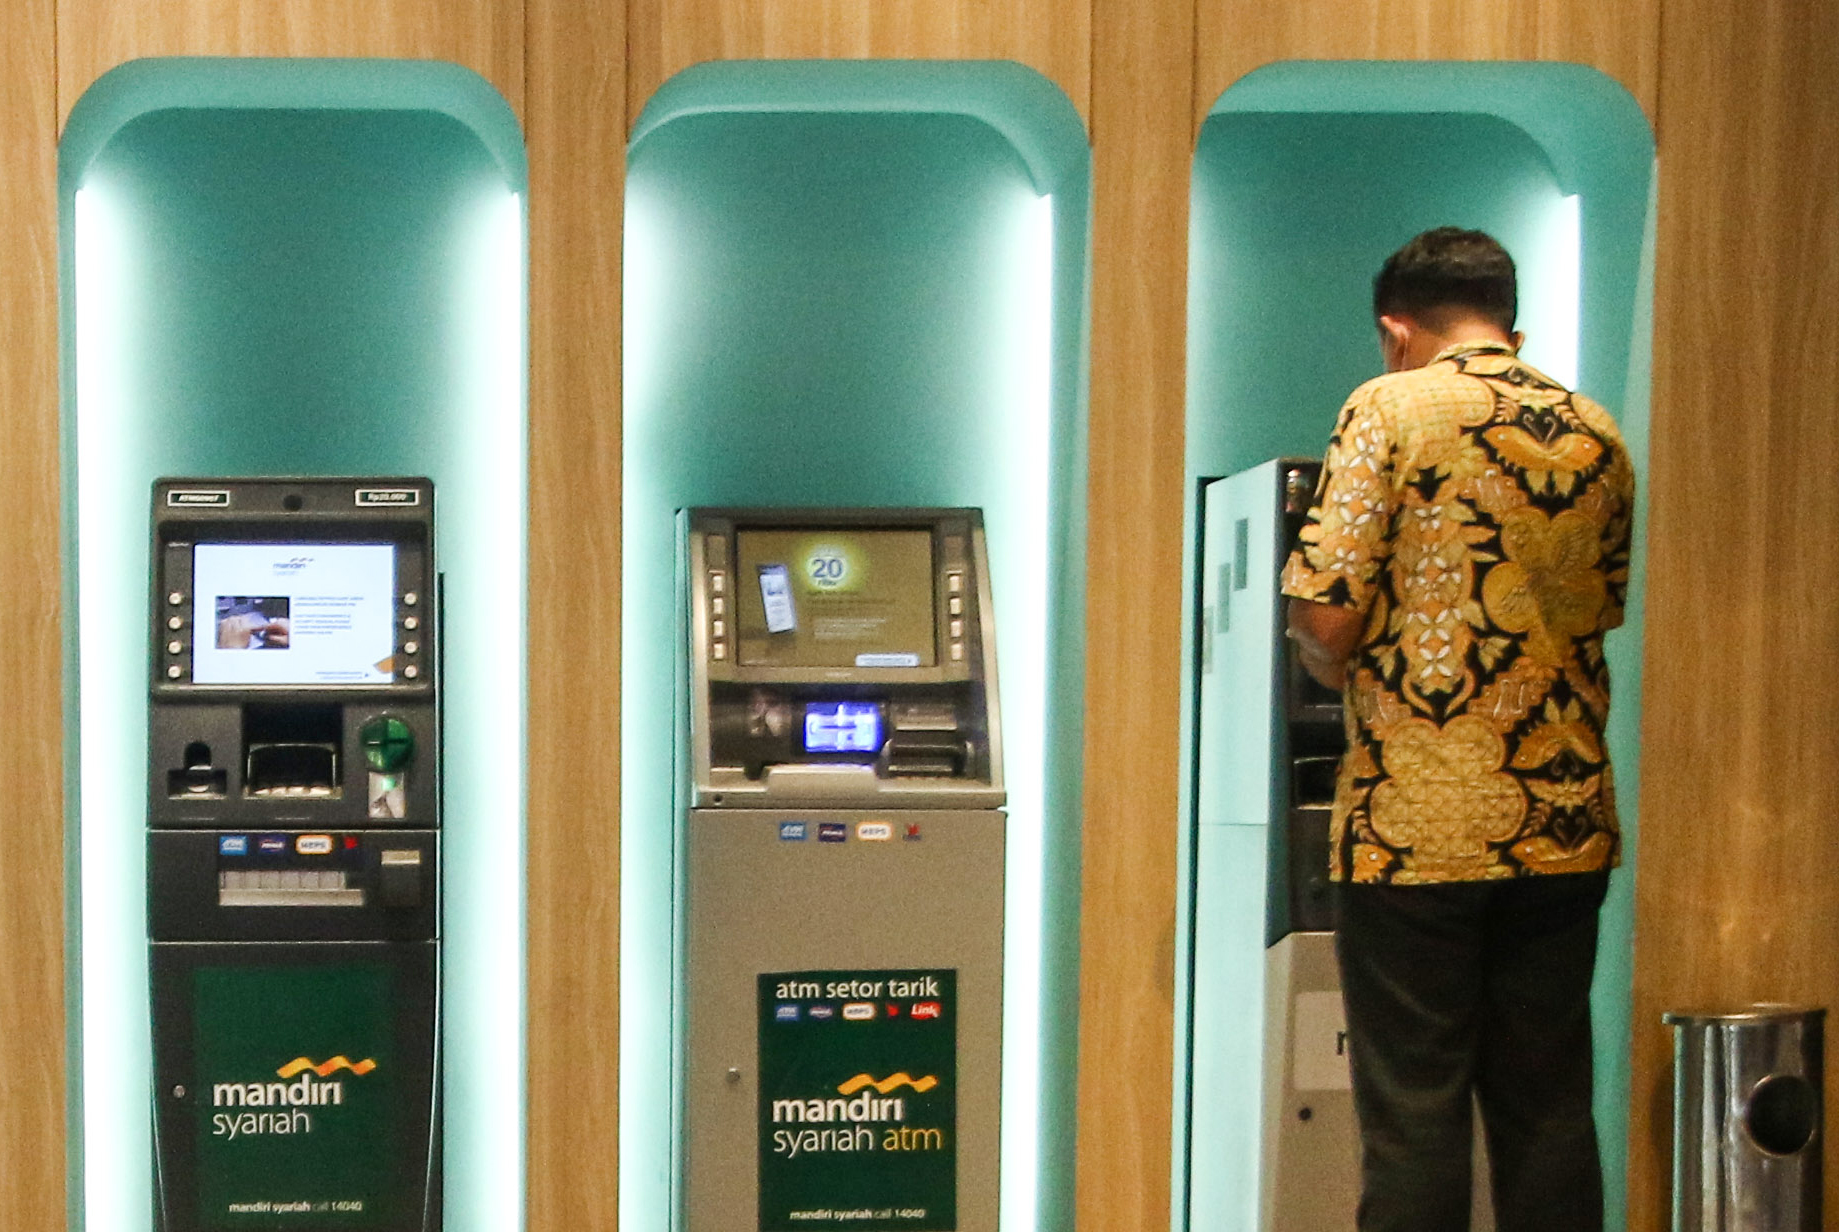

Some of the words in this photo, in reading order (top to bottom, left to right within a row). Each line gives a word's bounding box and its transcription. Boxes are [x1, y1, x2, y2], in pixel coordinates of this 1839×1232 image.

[812, 558, 843, 578] 20
[776, 980, 819, 998] atm
[826, 980, 882, 998] setor
[888, 976, 938, 997] tarik
[912, 1003, 938, 1017] Link
[213, 1074, 341, 1106] mandiri
[772, 1091, 903, 1122] mandiri
[213, 1109, 310, 1140] syariah
[774, 1126, 873, 1158] syariah
[882, 1126, 941, 1150] atm
[229, 1202, 271, 1212] mandiri
[272, 1202, 310, 1214] syariah
[790, 1208, 832, 1220] mandiri
[834, 1208, 872, 1221] syariah
